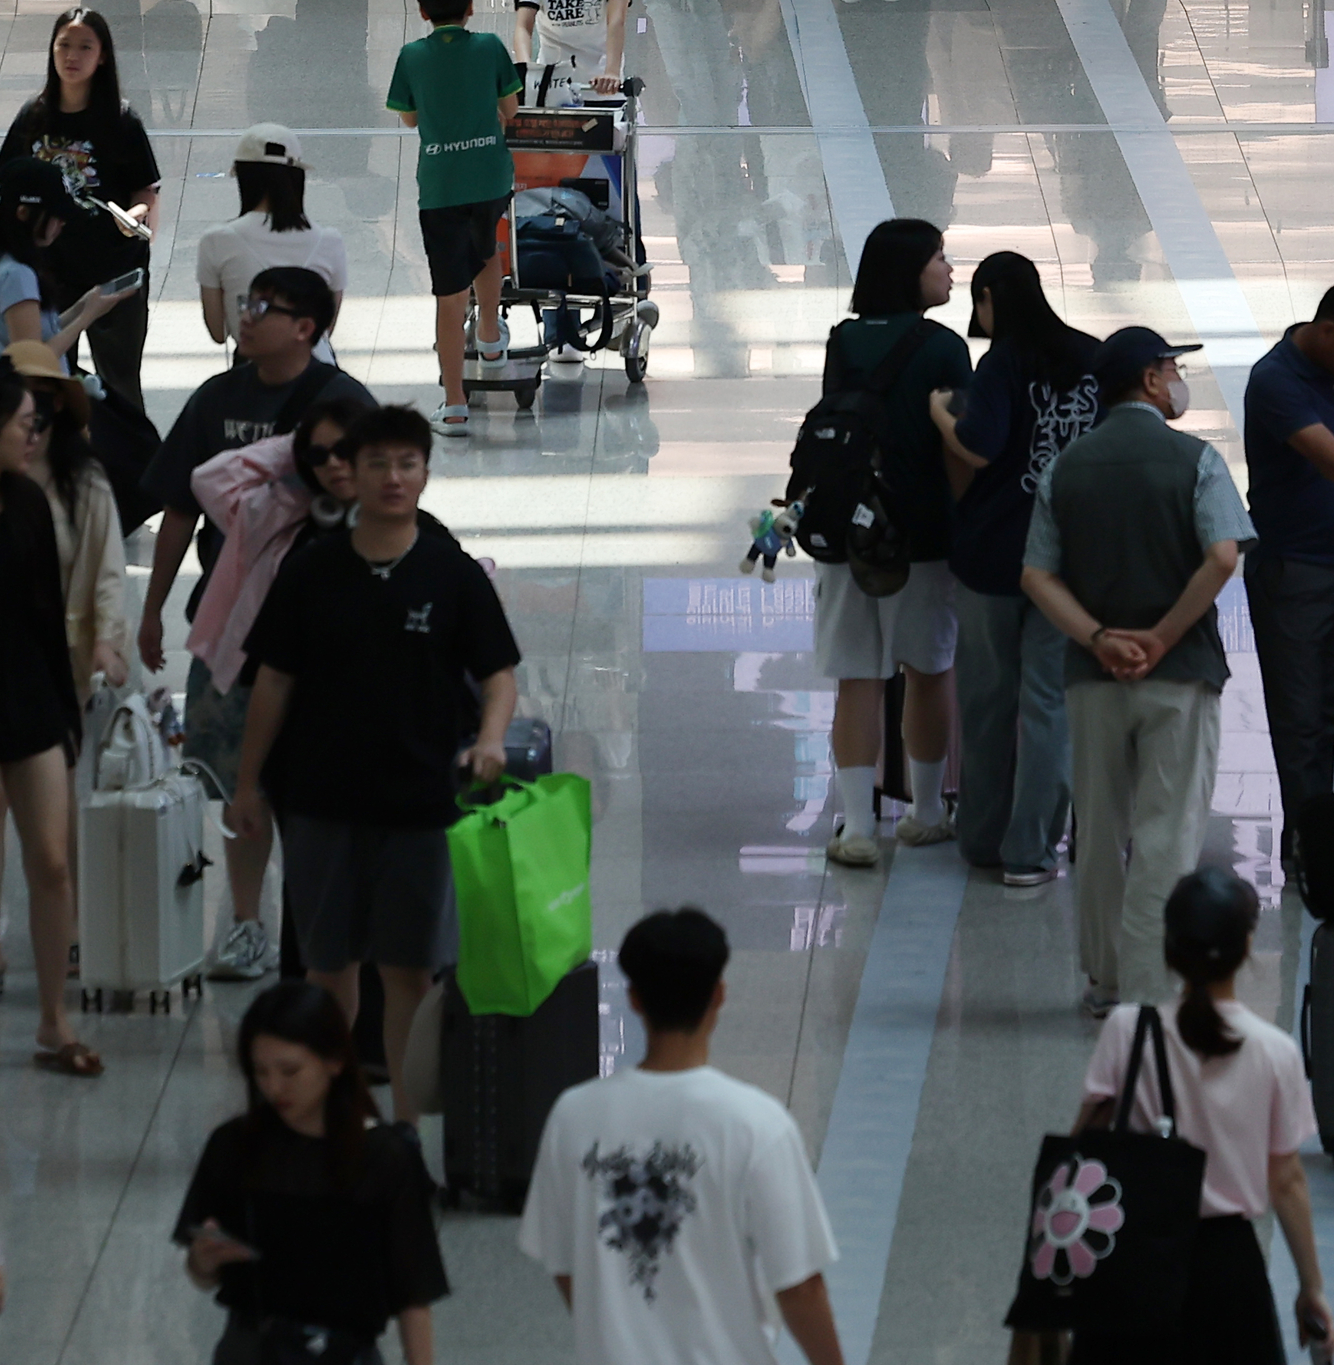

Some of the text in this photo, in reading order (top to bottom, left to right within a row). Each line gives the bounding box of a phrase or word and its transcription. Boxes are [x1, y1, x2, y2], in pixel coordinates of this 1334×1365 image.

[547, 0, 584, 10] TAKE
[547, 8, 584, 21] CARE
[444, 135, 496, 152] HYUNDAI
